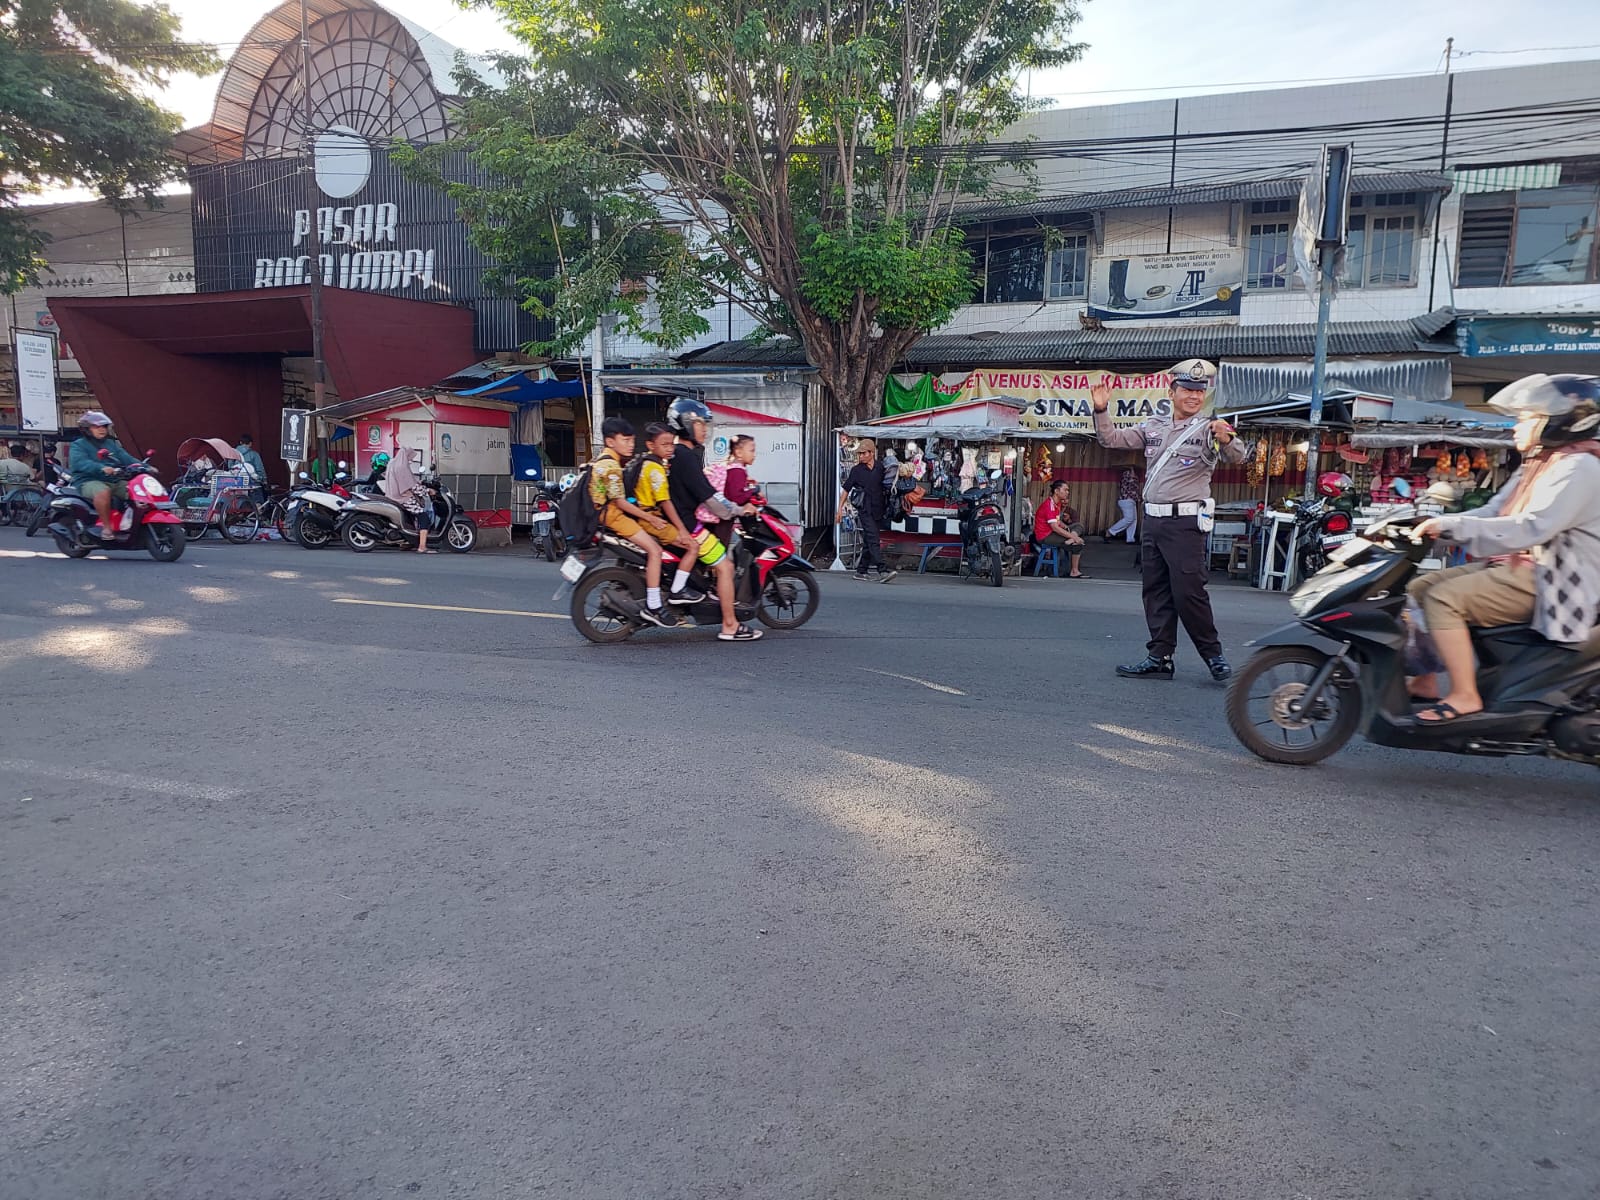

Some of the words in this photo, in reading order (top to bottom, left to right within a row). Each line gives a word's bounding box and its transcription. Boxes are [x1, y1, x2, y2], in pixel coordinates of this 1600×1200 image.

[293, 202, 398, 247] PASAR
[1176, 270, 1206, 296] AP
[1101, 373, 1175, 390] KATARIN
[1034, 398, 1092, 417] SINA
[1115, 398, 1171, 418] MAS
[487, 437, 506, 451] jatim
[771, 440, 797, 452] jatim
